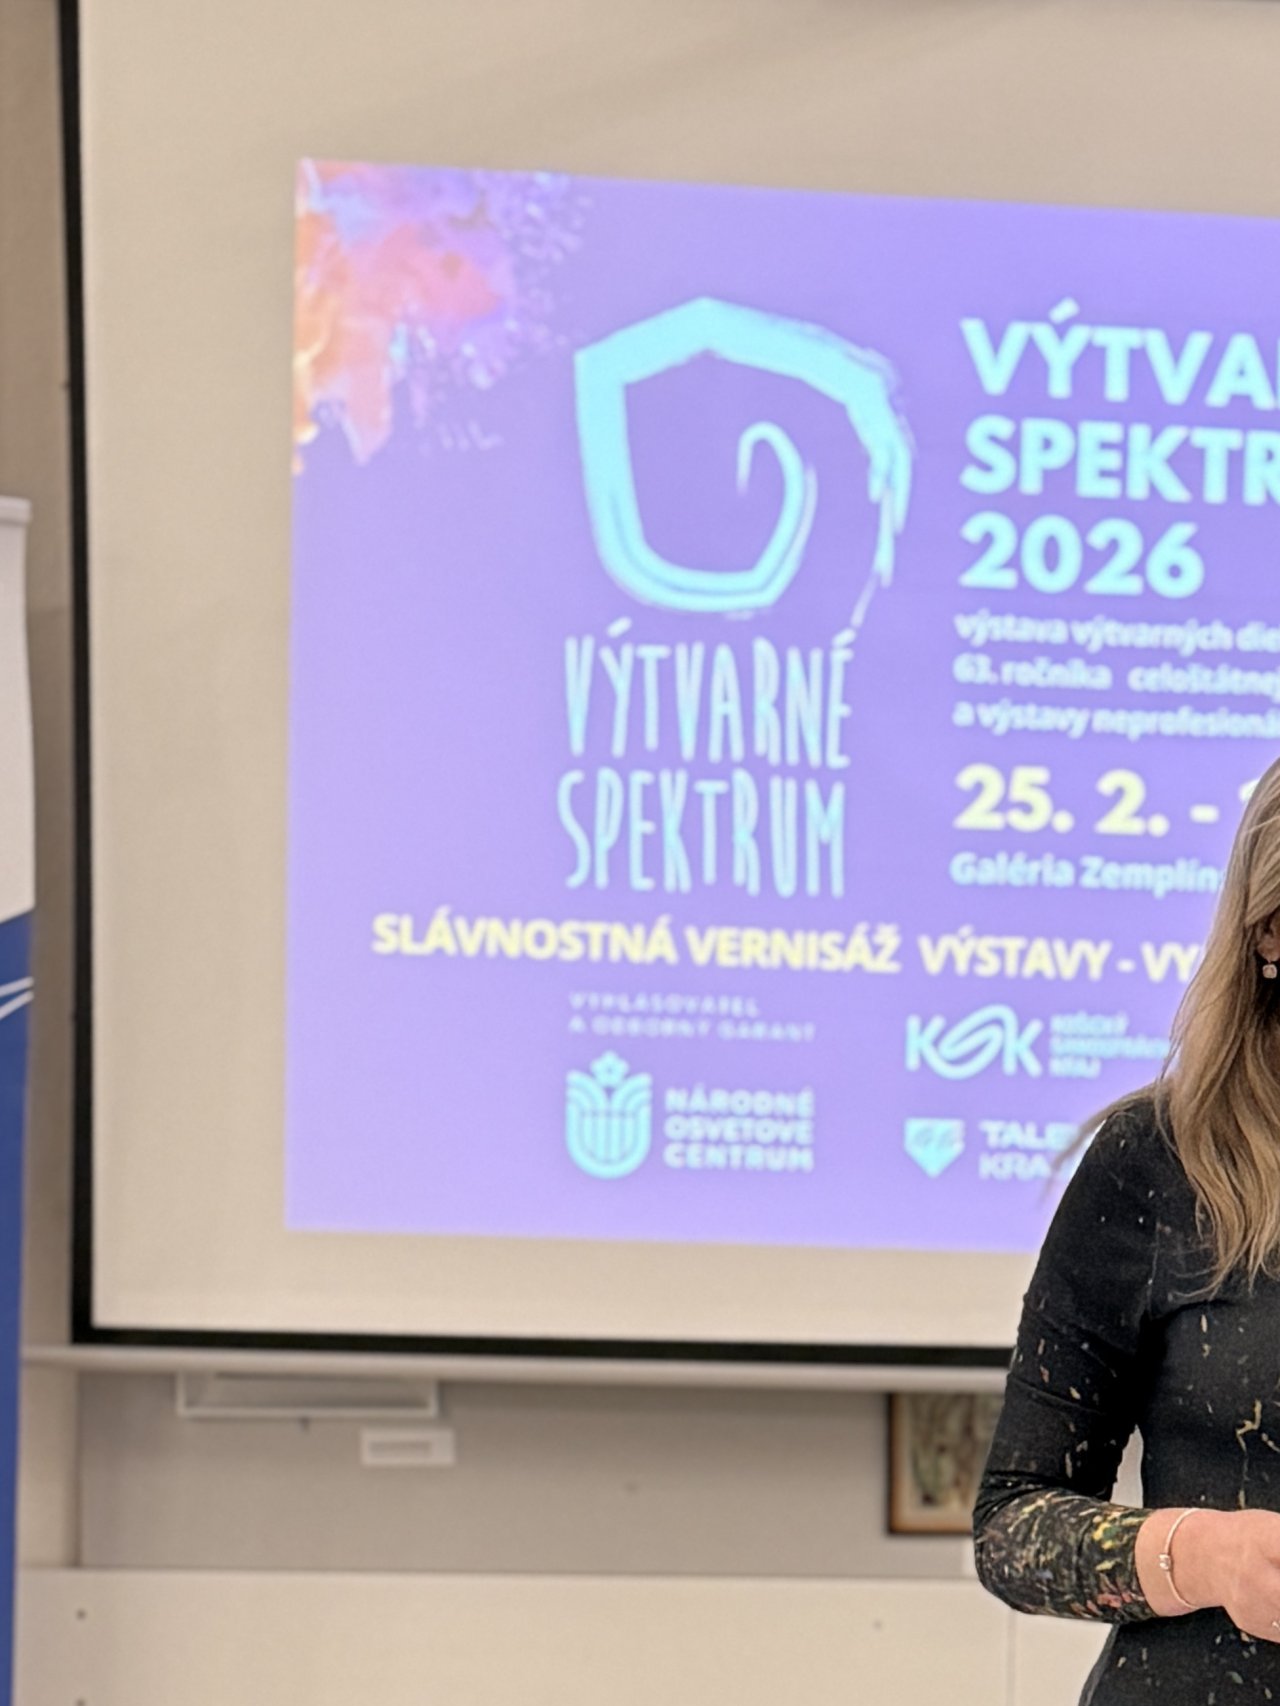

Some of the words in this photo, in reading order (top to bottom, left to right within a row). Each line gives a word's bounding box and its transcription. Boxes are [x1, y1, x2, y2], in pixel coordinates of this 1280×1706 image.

[959, 511, 1204, 598] 2026
[564, 616, 856, 769] VÝTVARNÉ
[557, 766, 845, 899] SPEKTRUM
[952, 763, 1074, 832] 25.
[1094, 769, 1170, 837] 2.
[950, 851, 1075, 886] Galéria
[1079, 855, 1223, 899] Zemplín
[371, 906, 678, 965] SLÁVNOSTNÁ
[685, 921, 900, 974] VERNISÁŽ
[917, 924, 1112, 981] VÝSTAVY
[663, 1142, 814, 1173] CENTRUM
